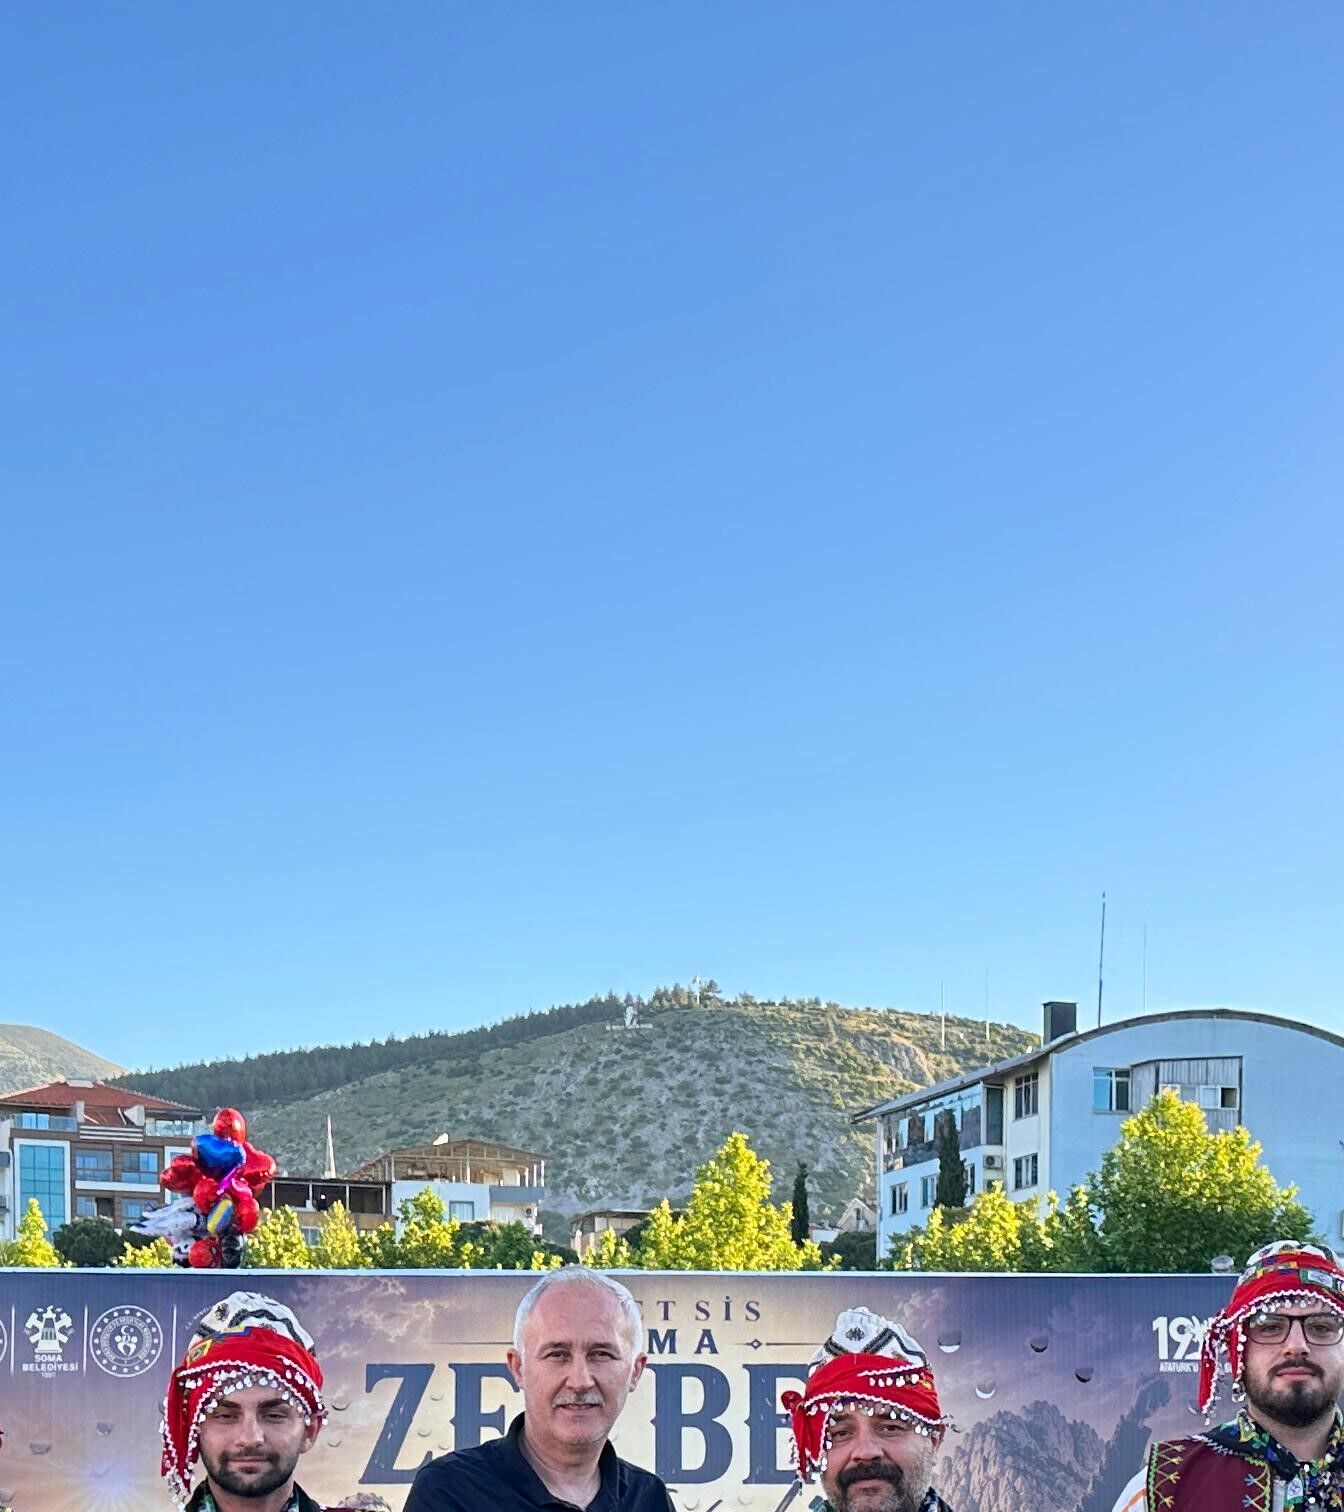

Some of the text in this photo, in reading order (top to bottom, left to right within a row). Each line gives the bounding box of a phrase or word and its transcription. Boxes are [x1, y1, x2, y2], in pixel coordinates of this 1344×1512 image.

[695, 1295, 761, 1322] SİS
[646, 1328, 719, 1355] MA
[22, 1361, 79, 1372] BELEDİYESİ
[34, 1354, 63, 1363] SOMA
